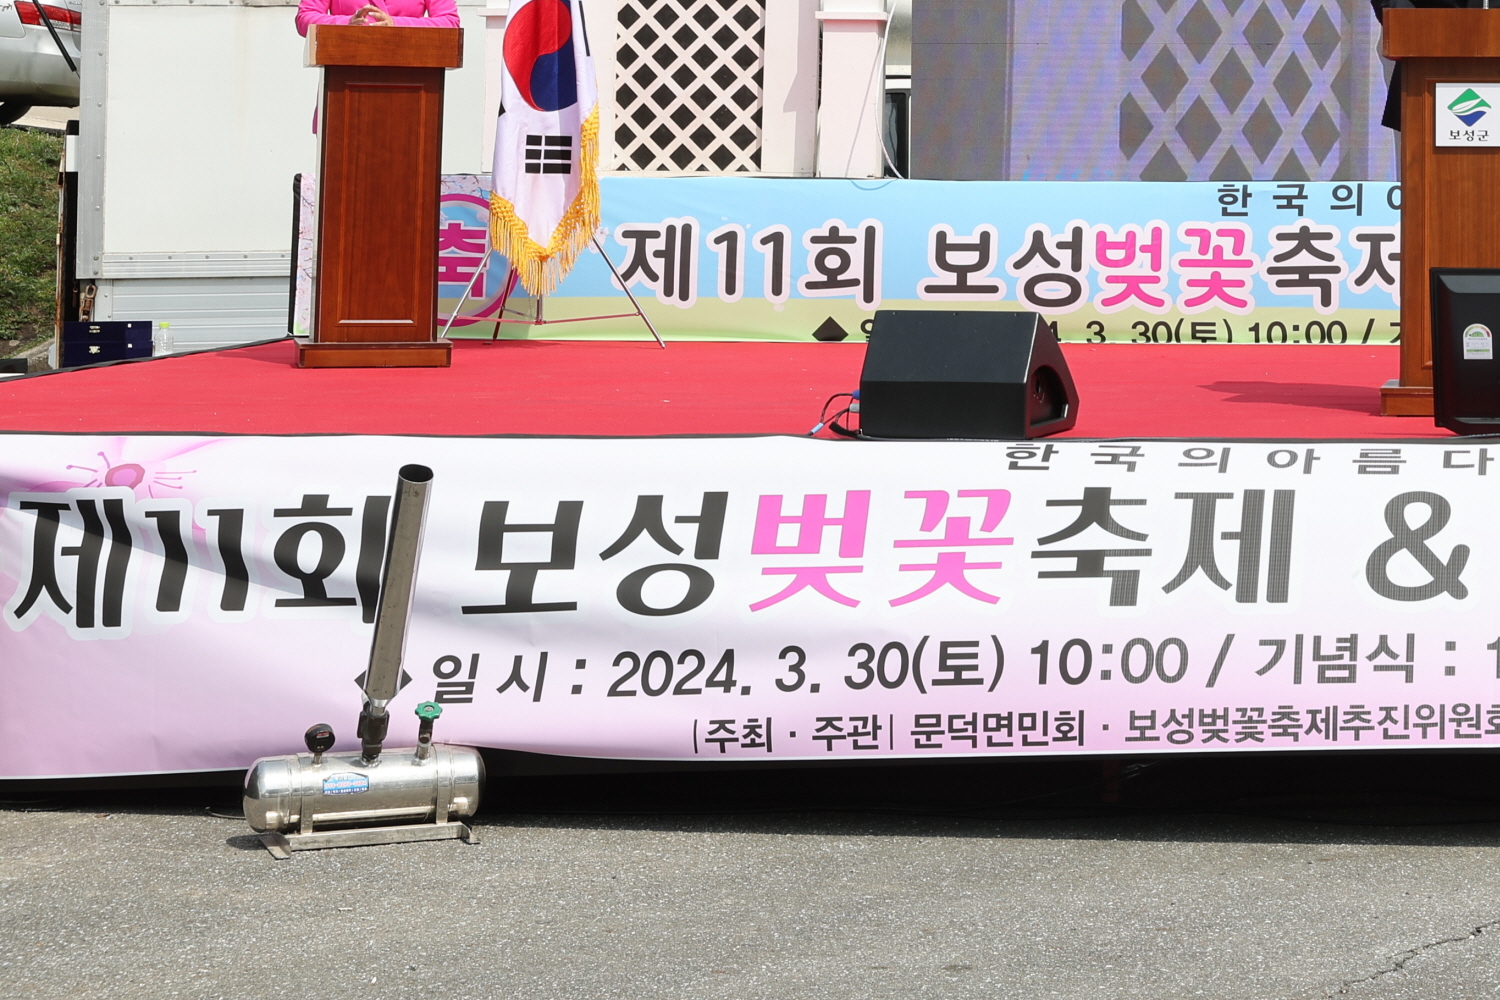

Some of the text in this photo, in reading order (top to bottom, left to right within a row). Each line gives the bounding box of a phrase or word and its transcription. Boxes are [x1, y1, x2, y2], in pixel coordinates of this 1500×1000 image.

[1449, 130, 1489, 142] 보성군
[620, 224, 875, 303] 제11회
[1249, 319, 1348, 344] 10:00
[14, 494, 392, 628] 제11회
[461, 487, 1295, 617] 보성벚꽃축제
[1366, 492, 1469, 601] &
[607, 648, 751, 697] 2024.
[775, 645, 821, 694] 3.
[844, 634, 1005, 694] 30(토)
[1030, 637, 1189, 686] 10:00
[1255, 633, 1415, 685] 기념식
[910, 709, 1085, 749] 문덕면민회
